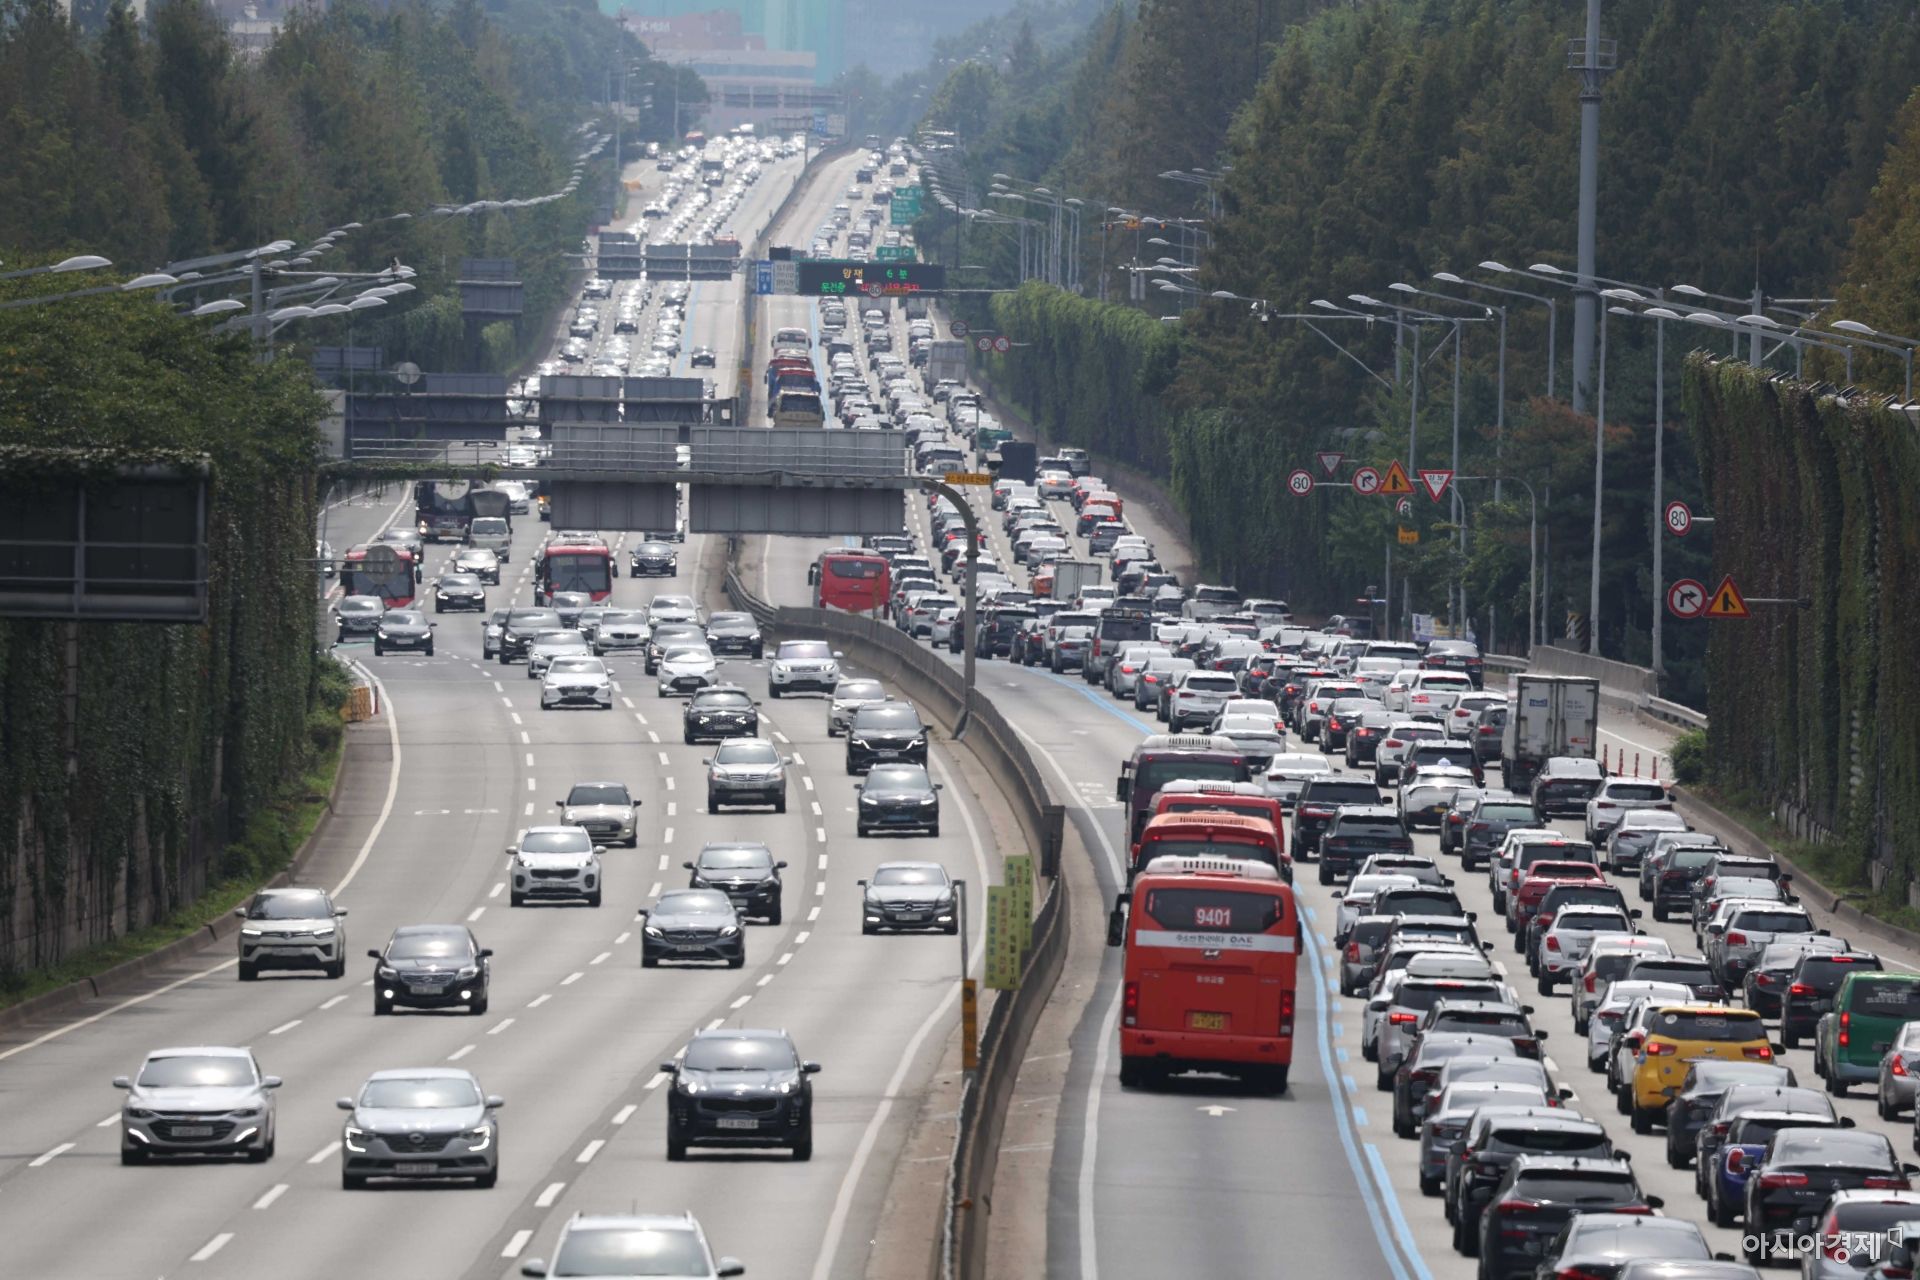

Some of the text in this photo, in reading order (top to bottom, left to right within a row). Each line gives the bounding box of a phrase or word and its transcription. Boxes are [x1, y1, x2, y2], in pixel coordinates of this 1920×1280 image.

[869, 286, 881, 294] 80
[1293, 476, 1308, 489] 80
[1671, 510, 1686, 526] 80
[1196, 907, 1231, 926] 9401
